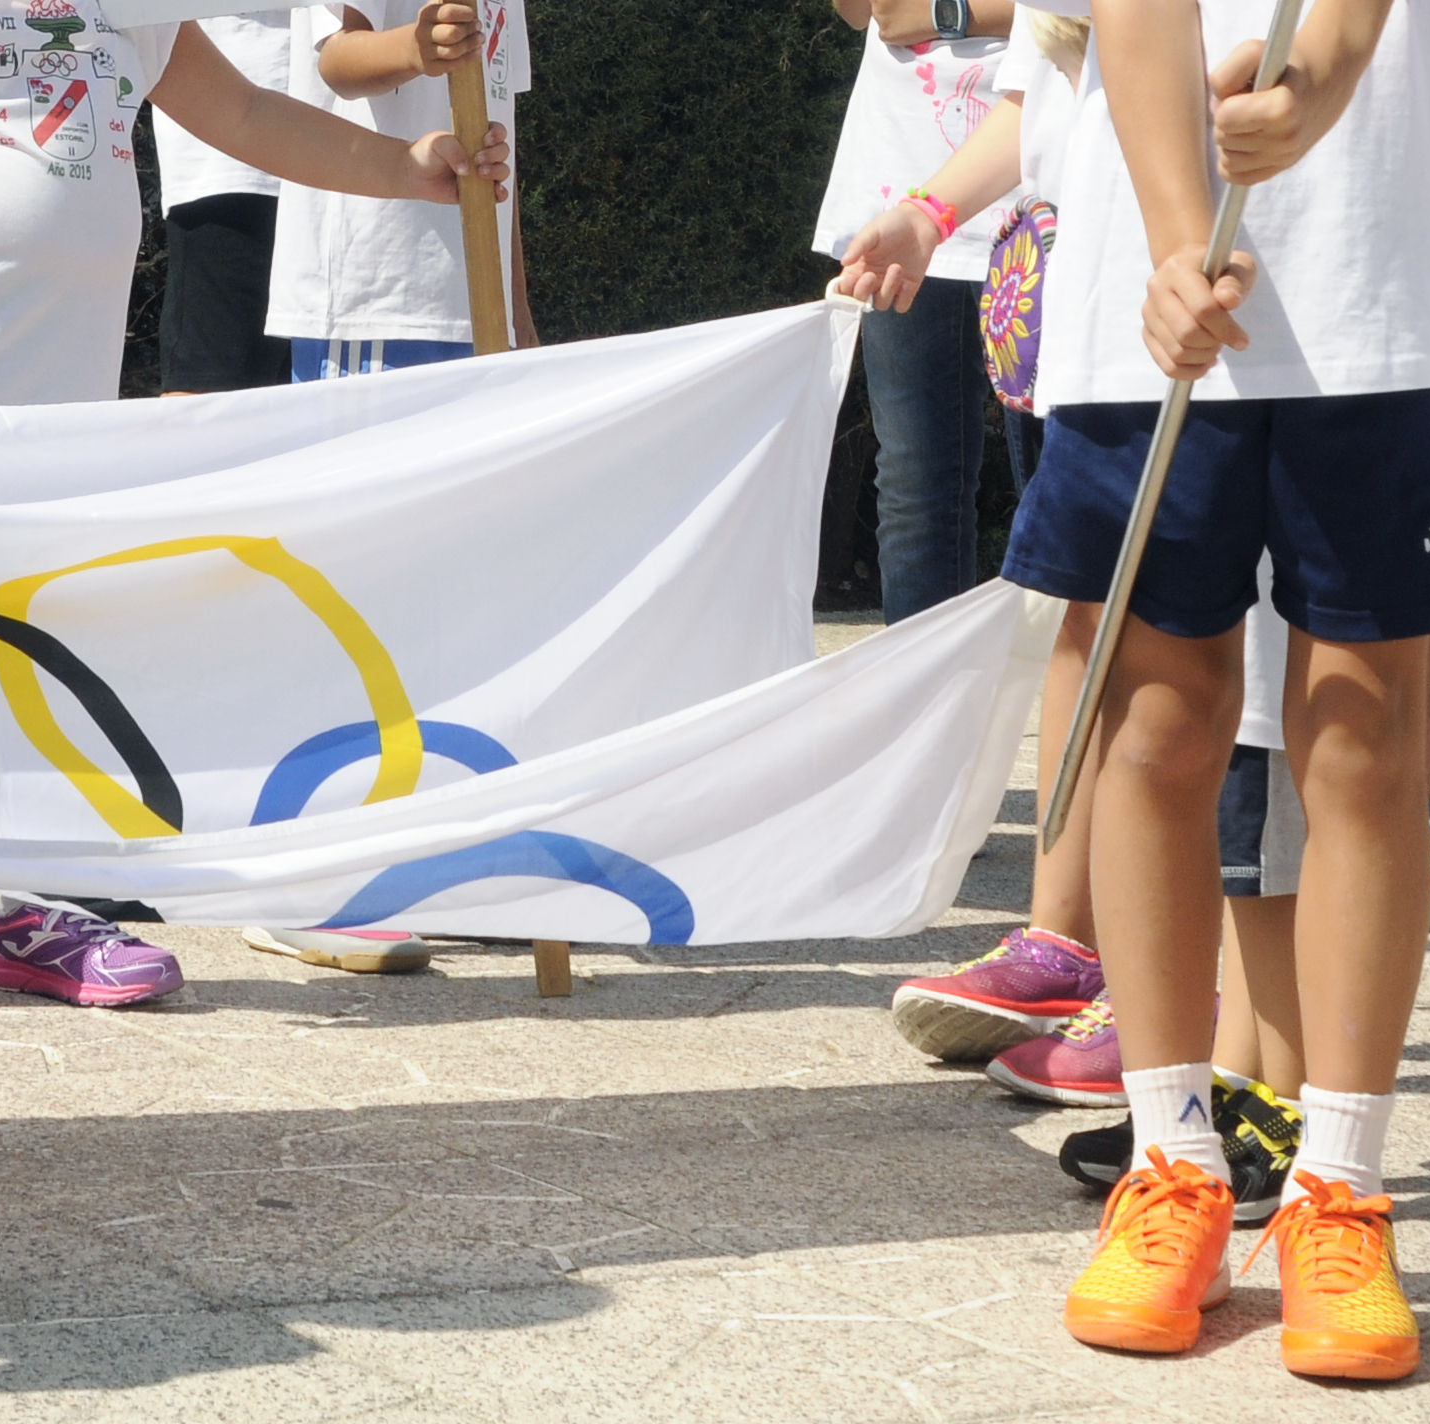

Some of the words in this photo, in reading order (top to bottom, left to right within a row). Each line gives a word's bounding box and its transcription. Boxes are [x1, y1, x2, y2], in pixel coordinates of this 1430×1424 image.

[109, 118, 126, 133] del
[47, 161, 65, 177] Año
[69, 163, 92, 181] 2015
